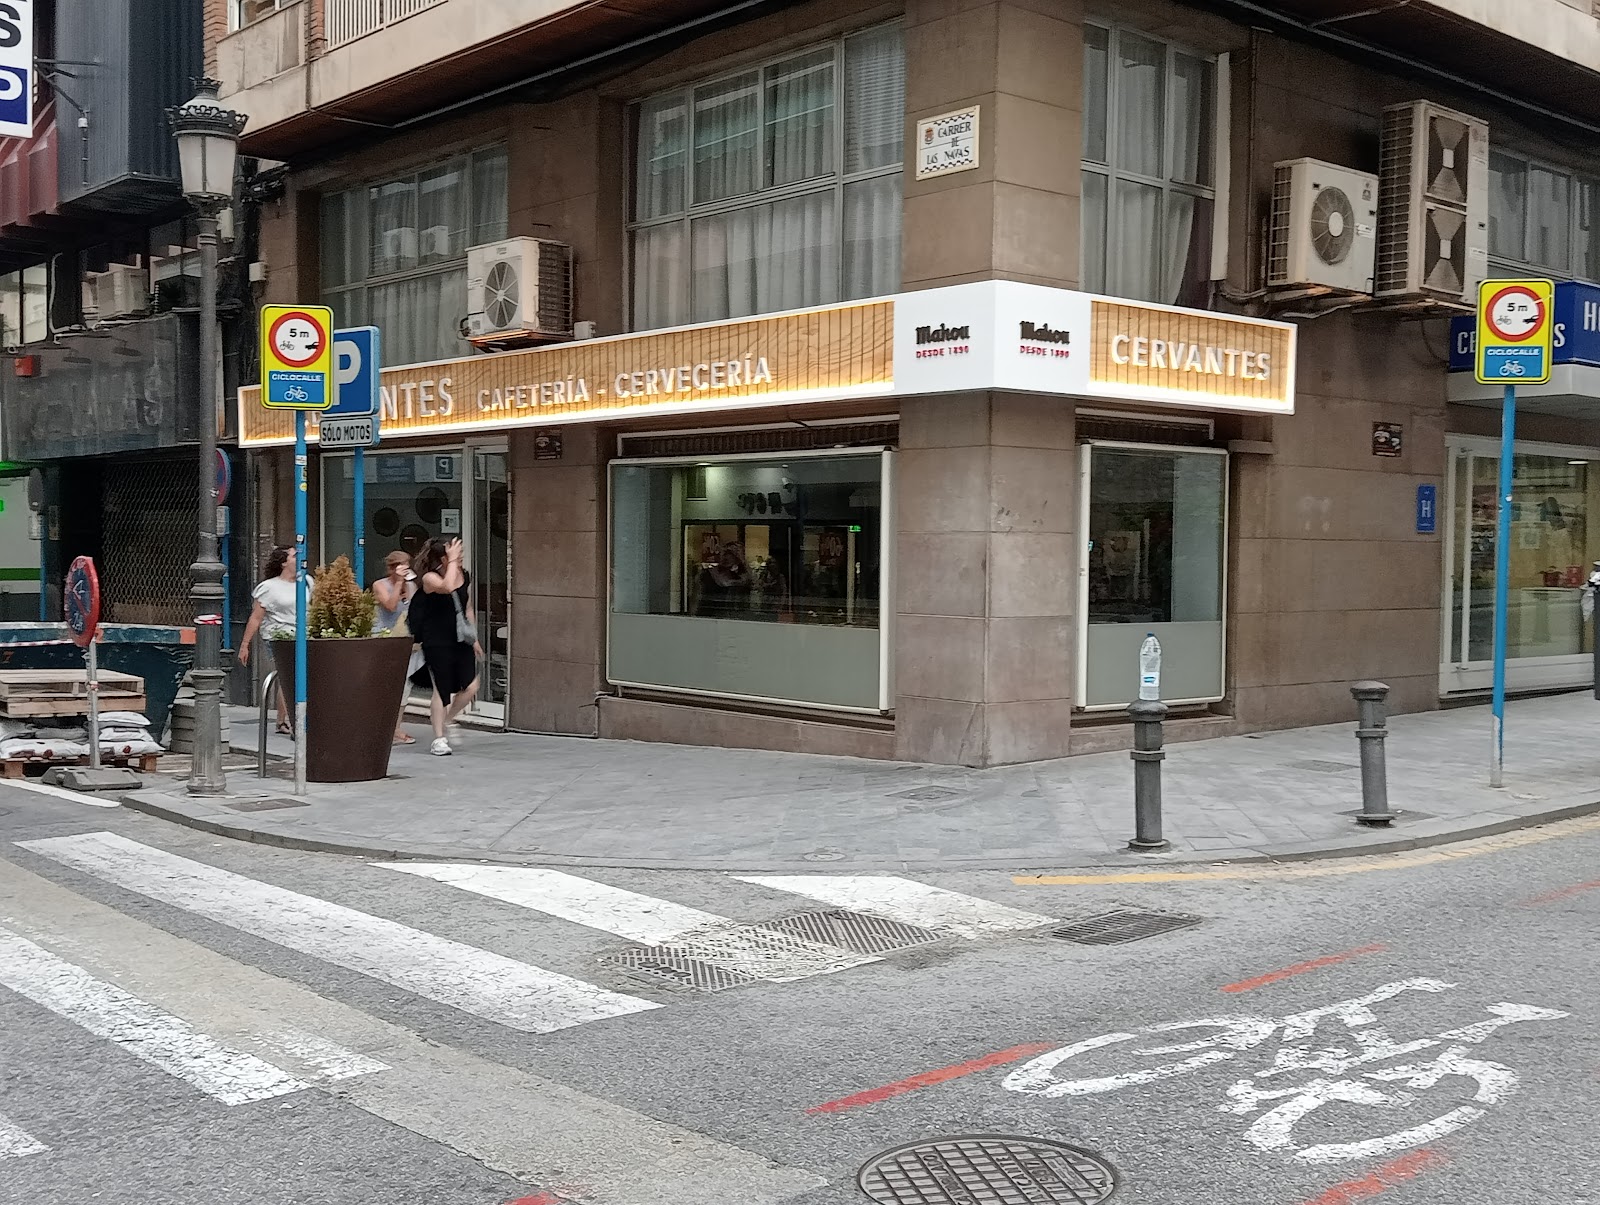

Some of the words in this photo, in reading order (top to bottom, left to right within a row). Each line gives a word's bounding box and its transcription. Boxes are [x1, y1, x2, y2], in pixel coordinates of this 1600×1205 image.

[937, 121, 972, 138] CARRER
[951, 136, 960, 148] DE
[1506, 302, 1516, 312] 5
[1517, 304, 1528, 312] m
[1583, 300, 1600, 332] H
[289, 328, 298, 338] 5
[299, 330, 310, 338] m
[916, 322, 970, 345] Mahou
[1020, 320, 1070, 345] Mahou
[916, 347, 945, 359] DESDE
[948, 345, 970, 355] 1890
[1020, 345, 1048, 357] DESDE
[1050, 348, 1070, 359] 1890
[1111, 334, 1271, 381] CERVANTES
[1486, 348, 1540, 356] CICLOCALLE
[271, 373, 322, 382] CICLOCALLE
[333, 340, 361, 406] P
[477, 375, 590, 412] CAFETERÍA
[614, 352, 772, 398] CERVECERÍA
[322, 423, 341, 442] SÓLO
[343, 424, 371, 441] MOTOS
[1421, 499, 1432, 518] H
